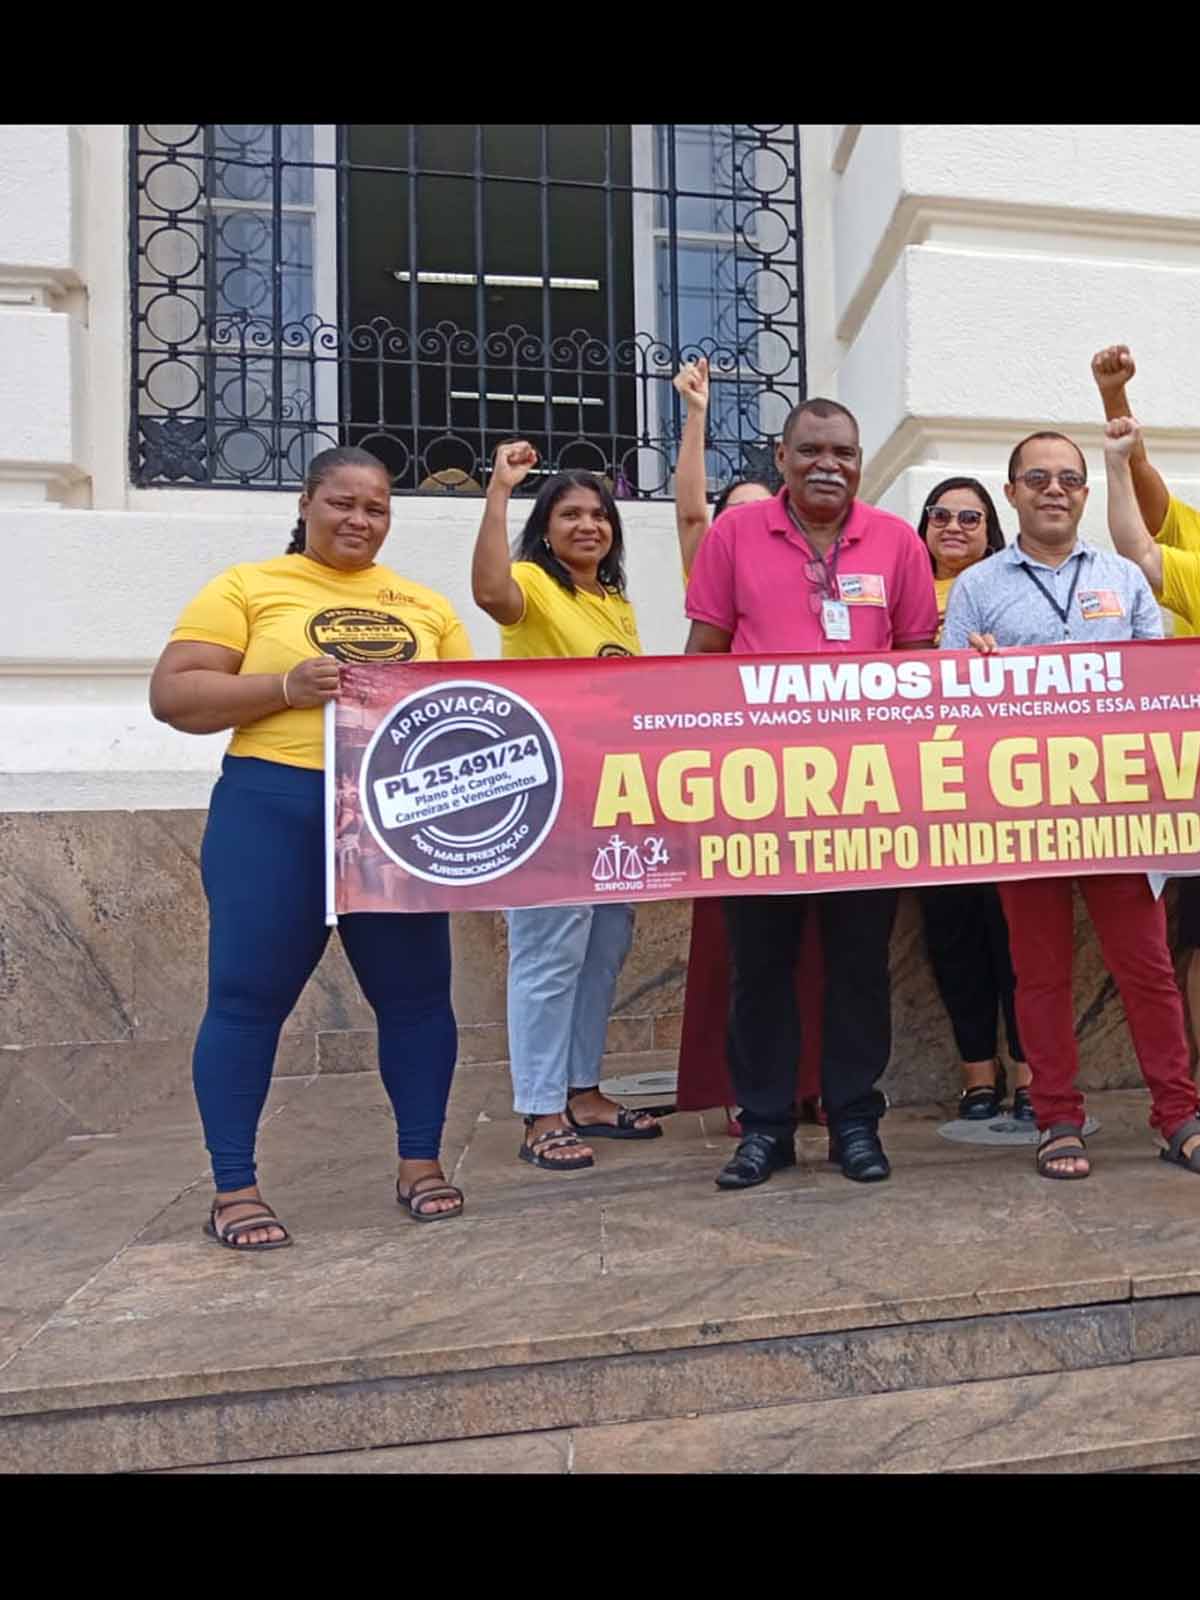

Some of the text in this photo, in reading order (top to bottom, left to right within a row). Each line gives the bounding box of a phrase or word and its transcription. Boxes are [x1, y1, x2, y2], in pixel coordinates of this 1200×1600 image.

[739, 652, 1124, 704] VAMOS LUTAR!
[389, 694, 511, 744] APROVAÇÃO
[632, 711, 744, 731] SERVIDORES
[748, 709, 812, 727] VAMOS
[817, 707, 861, 724] UNIR
[867, 705, 934, 724] FORÇAS
[940, 703, 983, 720] PARA
[987, 699, 1091, 717] VENCERMOS
[1097, 697, 1136, 713] ESSA
[384, 739, 538, 799] PL 25.491/24
[415, 771, 512, 806] Plano de Cargos,
[592, 744, 900, 827] AGORA
[918, 725, 967, 811] É
[395, 775, 536, 824] Carreiras e Vencimentos
[411, 824, 529, 862] POR MAIS PRESTAÇÃO
[701, 832, 781, 879] POR
[790, 825, 918, 875] TEMPO
